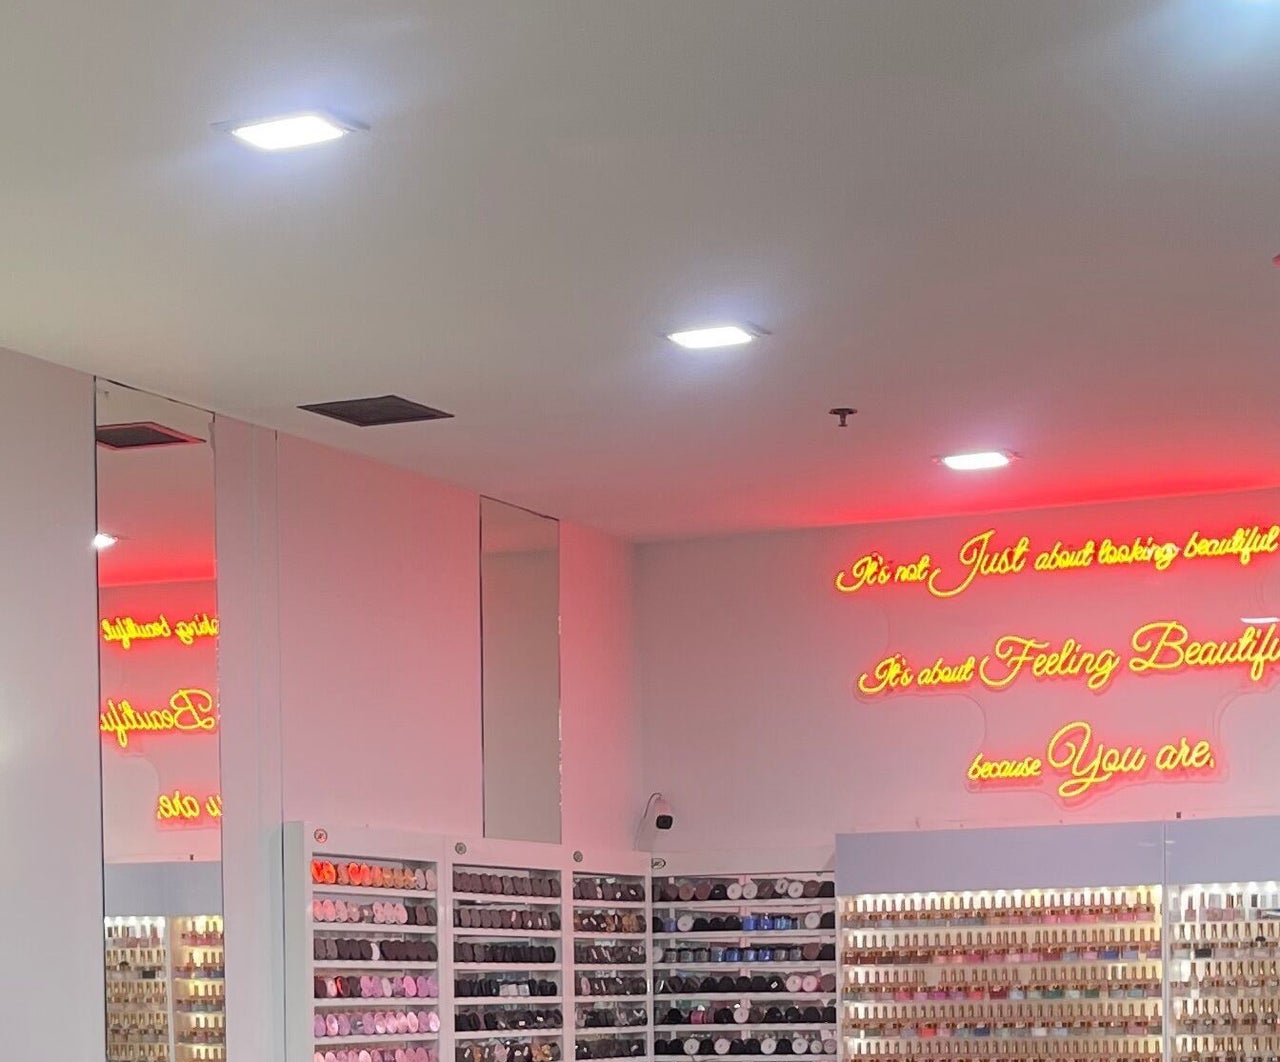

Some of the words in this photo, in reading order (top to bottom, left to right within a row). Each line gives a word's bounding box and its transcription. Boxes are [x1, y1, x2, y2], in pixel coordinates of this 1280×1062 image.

[835, 551, 891, 593] It's
[894, 554, 930, 582] not
[927, 528, 1031, 598] Just
[1034, 540, 1095, 571] about
[1098, 536, 1179, 571] looking
[1183, 525, 1280, 566] beautiful
[857, 653, 914, 695] It's
[917, 656, 976, 687] about
[978, 634, 1120, 691] Feeling
[967, 752, 1042, 780] because
[1046, 720, 1147, 798] You
